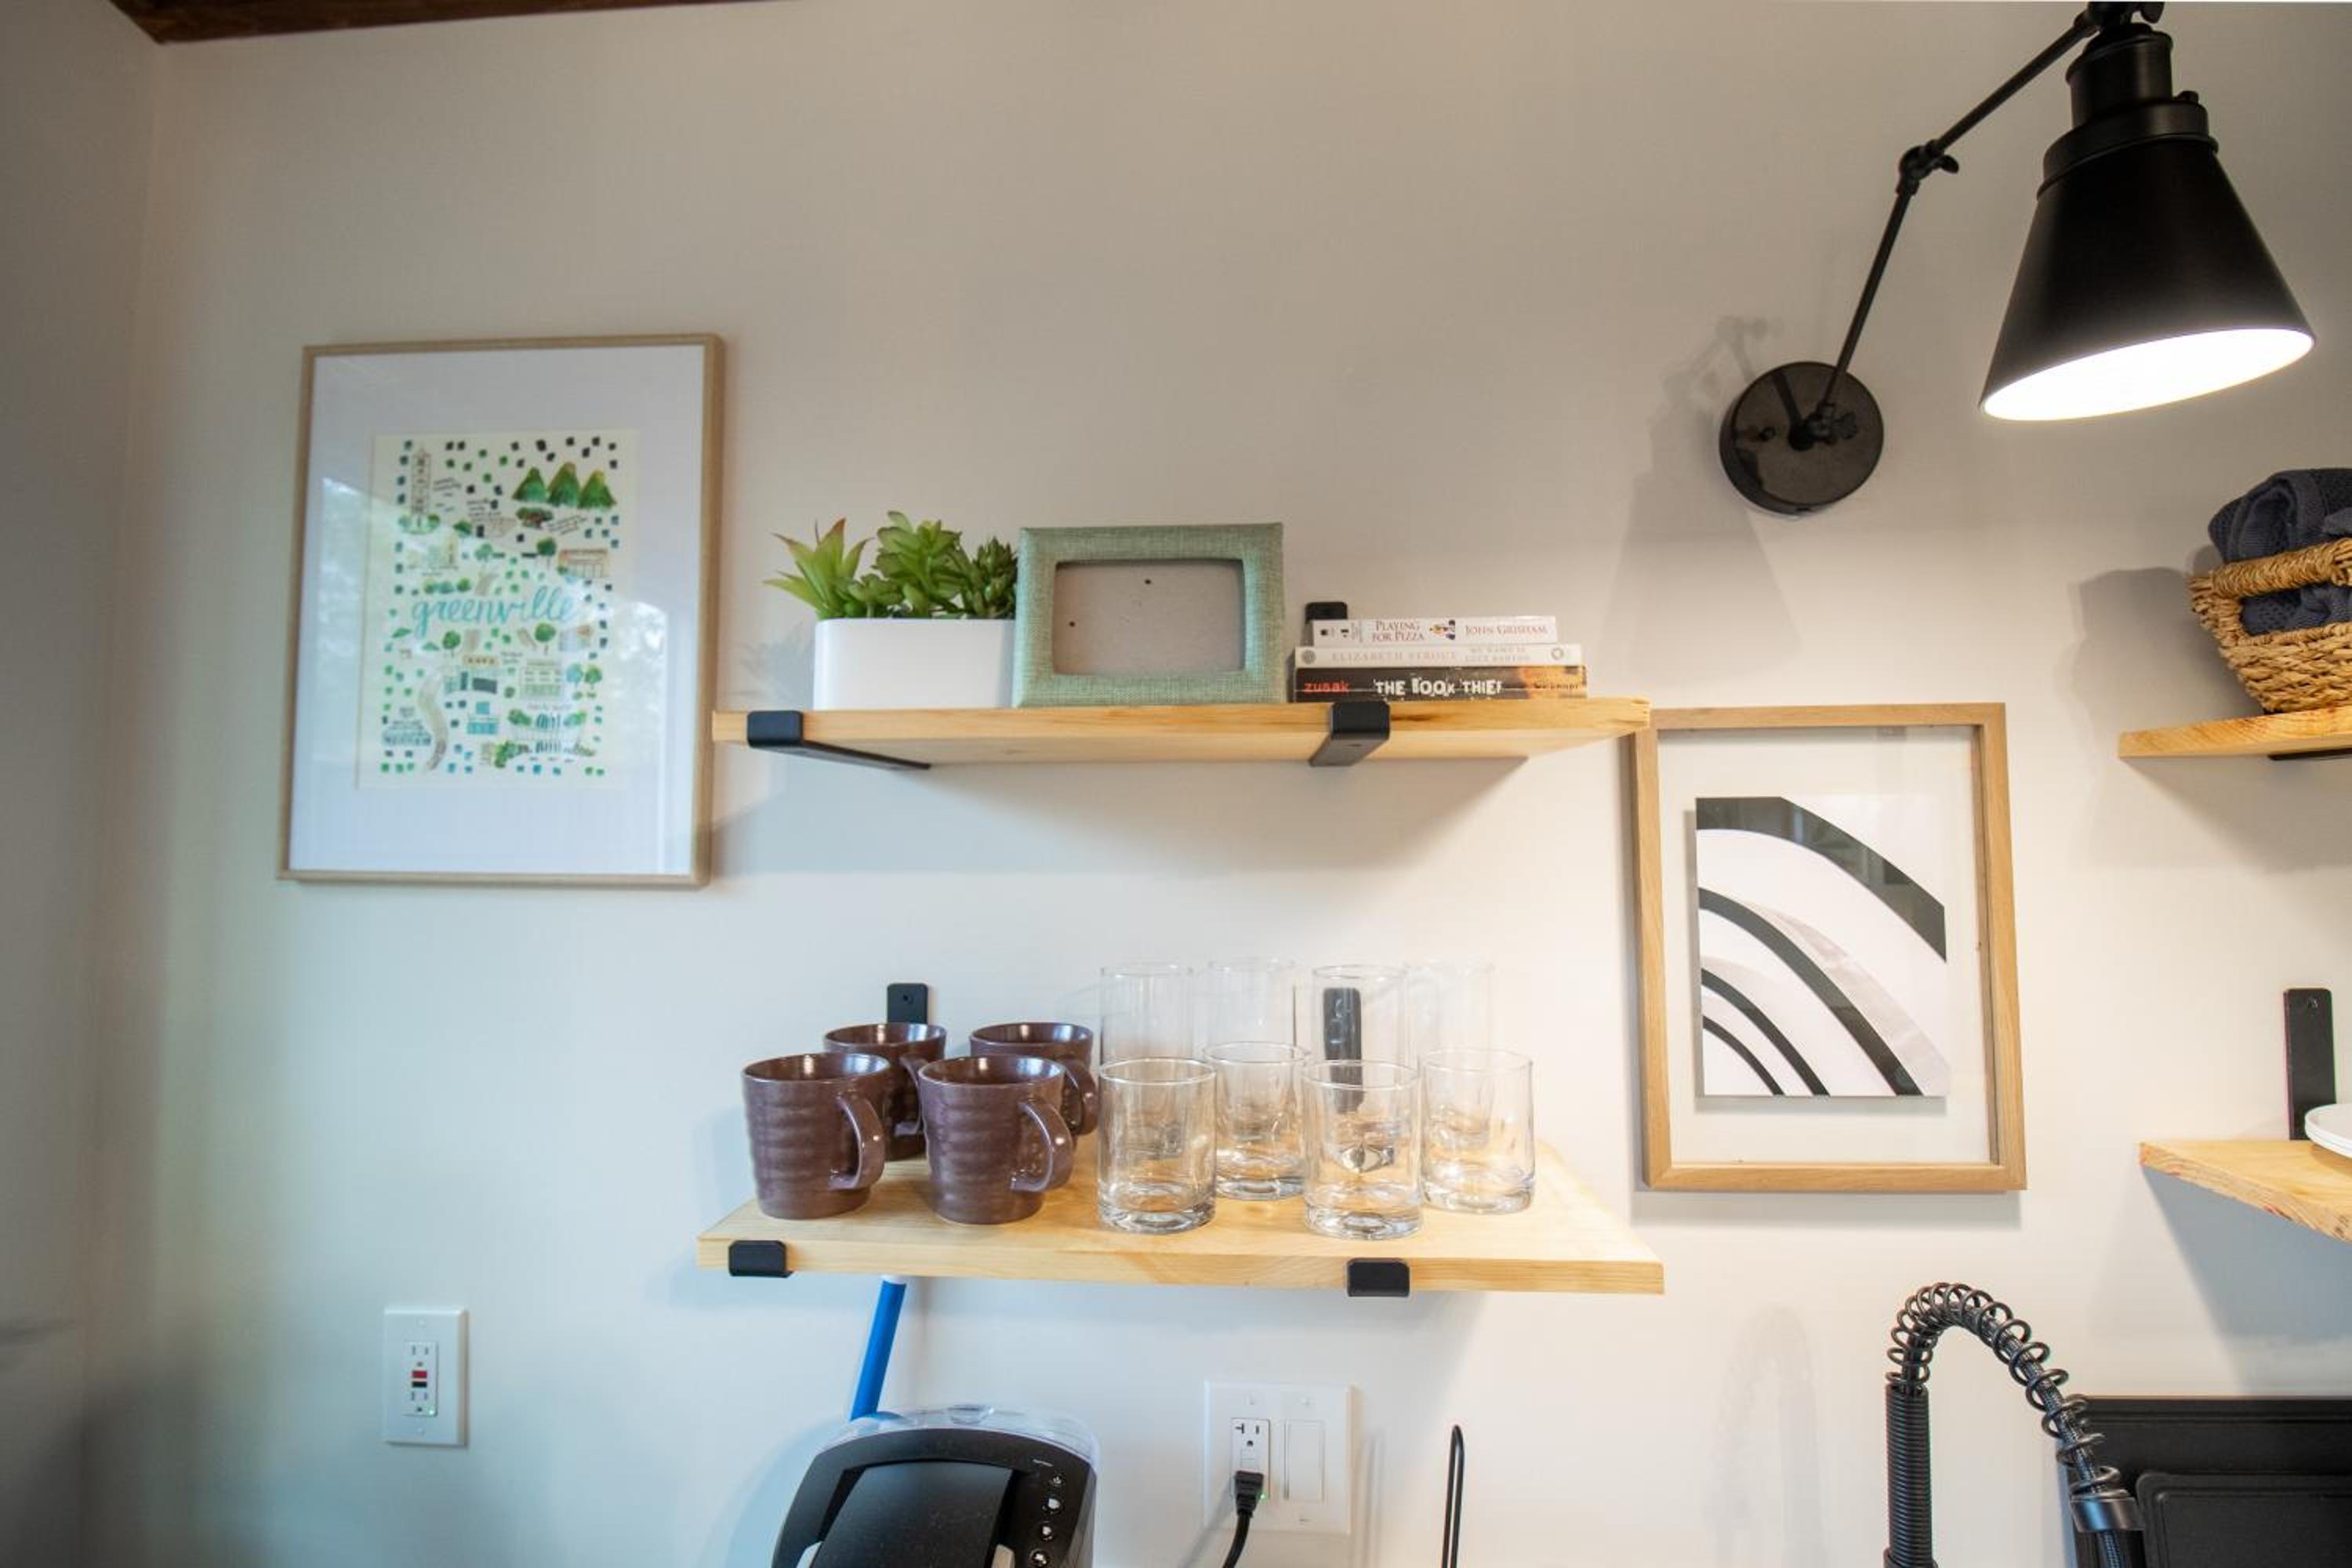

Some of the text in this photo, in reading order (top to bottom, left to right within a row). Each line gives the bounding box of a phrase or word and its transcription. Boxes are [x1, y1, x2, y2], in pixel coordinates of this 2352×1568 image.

[411, 586, 574, 639] greenville
[1375, 620, 1420, 630] PLAYING
[1465, 624, 1548, 637] JOHN GRISHAM
[1372, 631, 1425, 641] FOR PIZZA
[1374, 675, 1504, 696] THE BOOK THIEF
